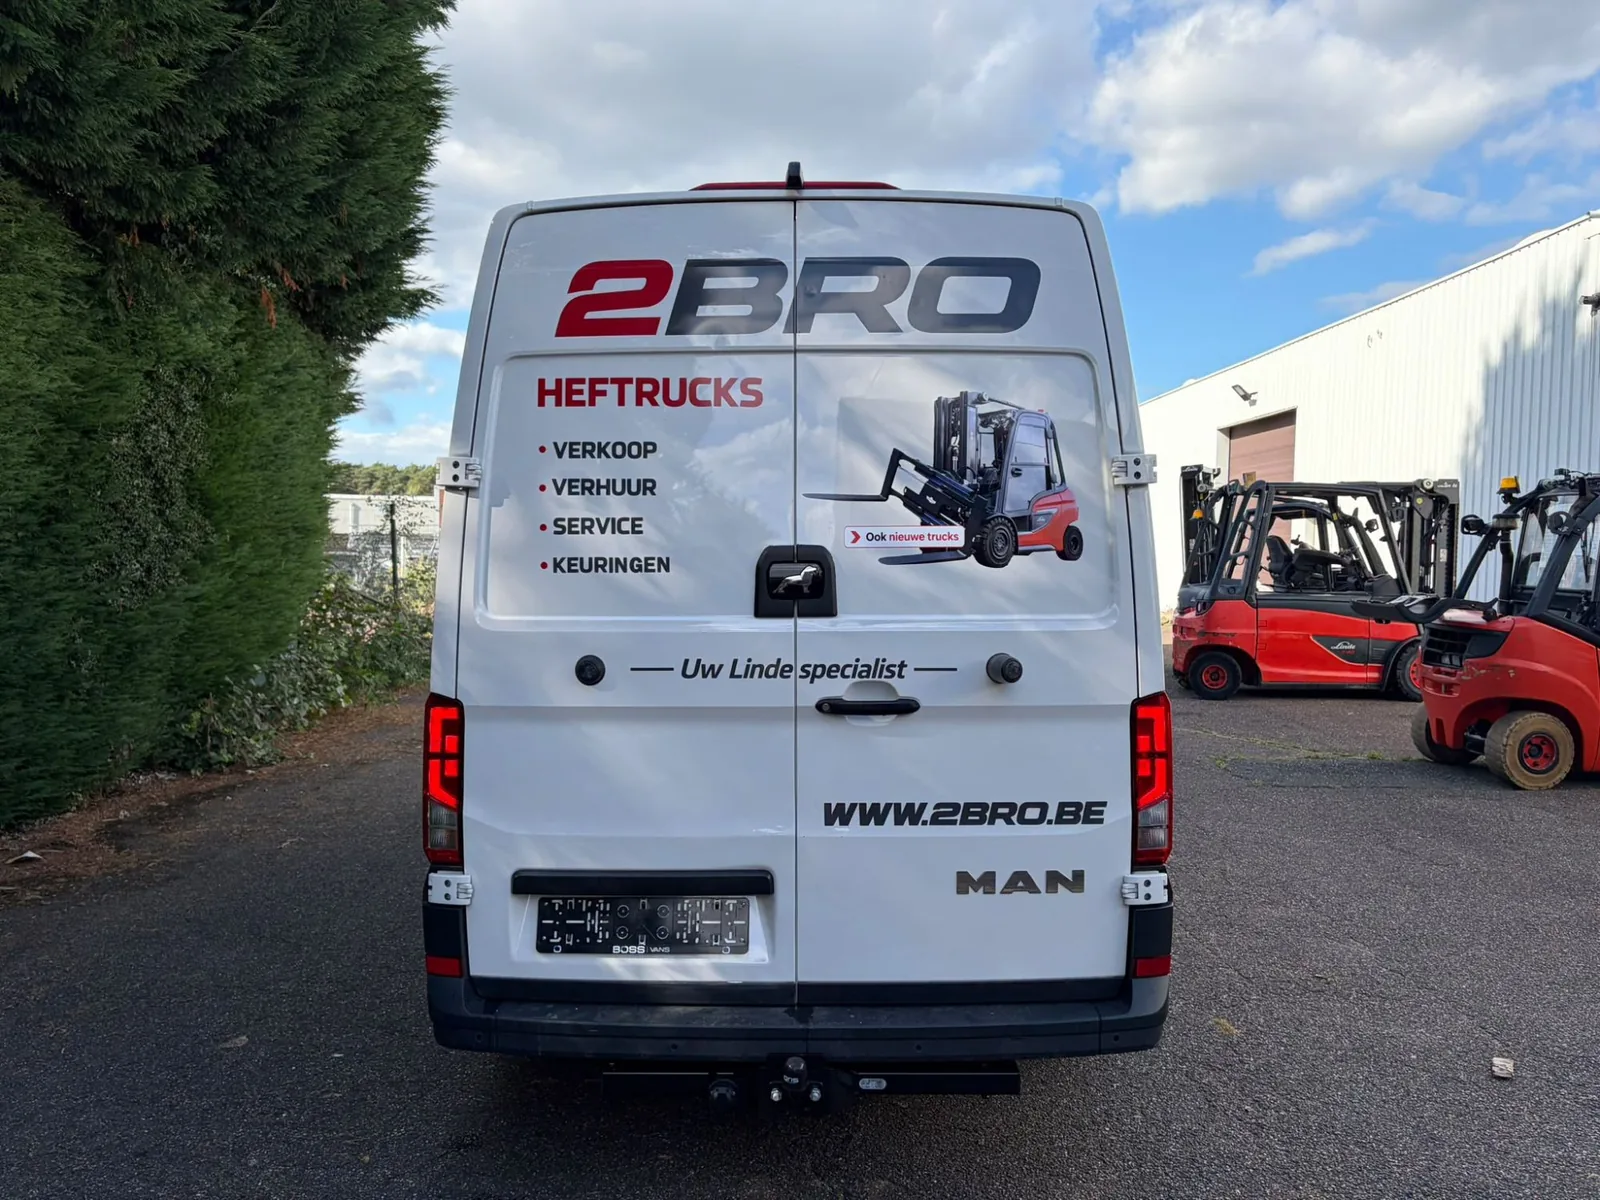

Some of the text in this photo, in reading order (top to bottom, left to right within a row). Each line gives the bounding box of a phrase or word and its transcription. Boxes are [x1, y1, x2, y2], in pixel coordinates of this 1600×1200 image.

[555, 257, 1041, 337] 2BRO
[537, 377, 763, 408] HEFTRUCKS
[553, 441, 658, 460] VERKOOP
[552, 478, 657, 496] VERHUUR
[553, 517, 643, 535] SERVICE
[866, 532, 959, 542] Ook nieuwe trucks
[552, 556, 671, 573] KEURINGEN
[682, 658, 908, 684] Uw Linde specialist
[824, 801, 1108, 826] WWW.2BRO.BE
[956, 870, 1086, 895] MAN
[612, 945, 645, 954] BOSS
